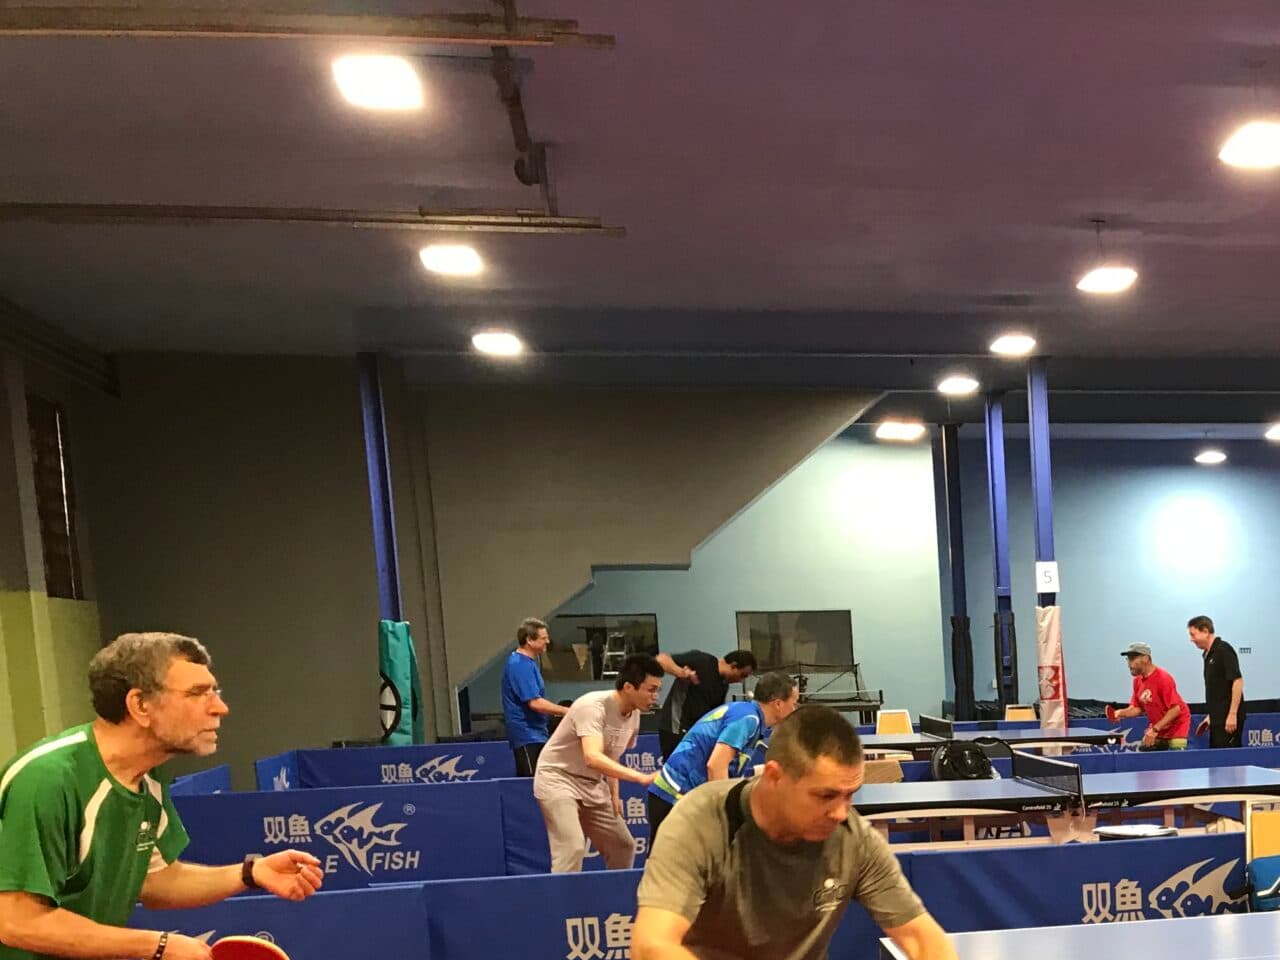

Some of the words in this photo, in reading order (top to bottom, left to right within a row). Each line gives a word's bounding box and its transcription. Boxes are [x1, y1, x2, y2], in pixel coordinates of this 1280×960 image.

[1043, 569, 1053, 584] 5
[263, 813, 313, 844] 双魚
[370, 850, 420, 871] FISH
[1081, 878, 1146, 925] 双魚
